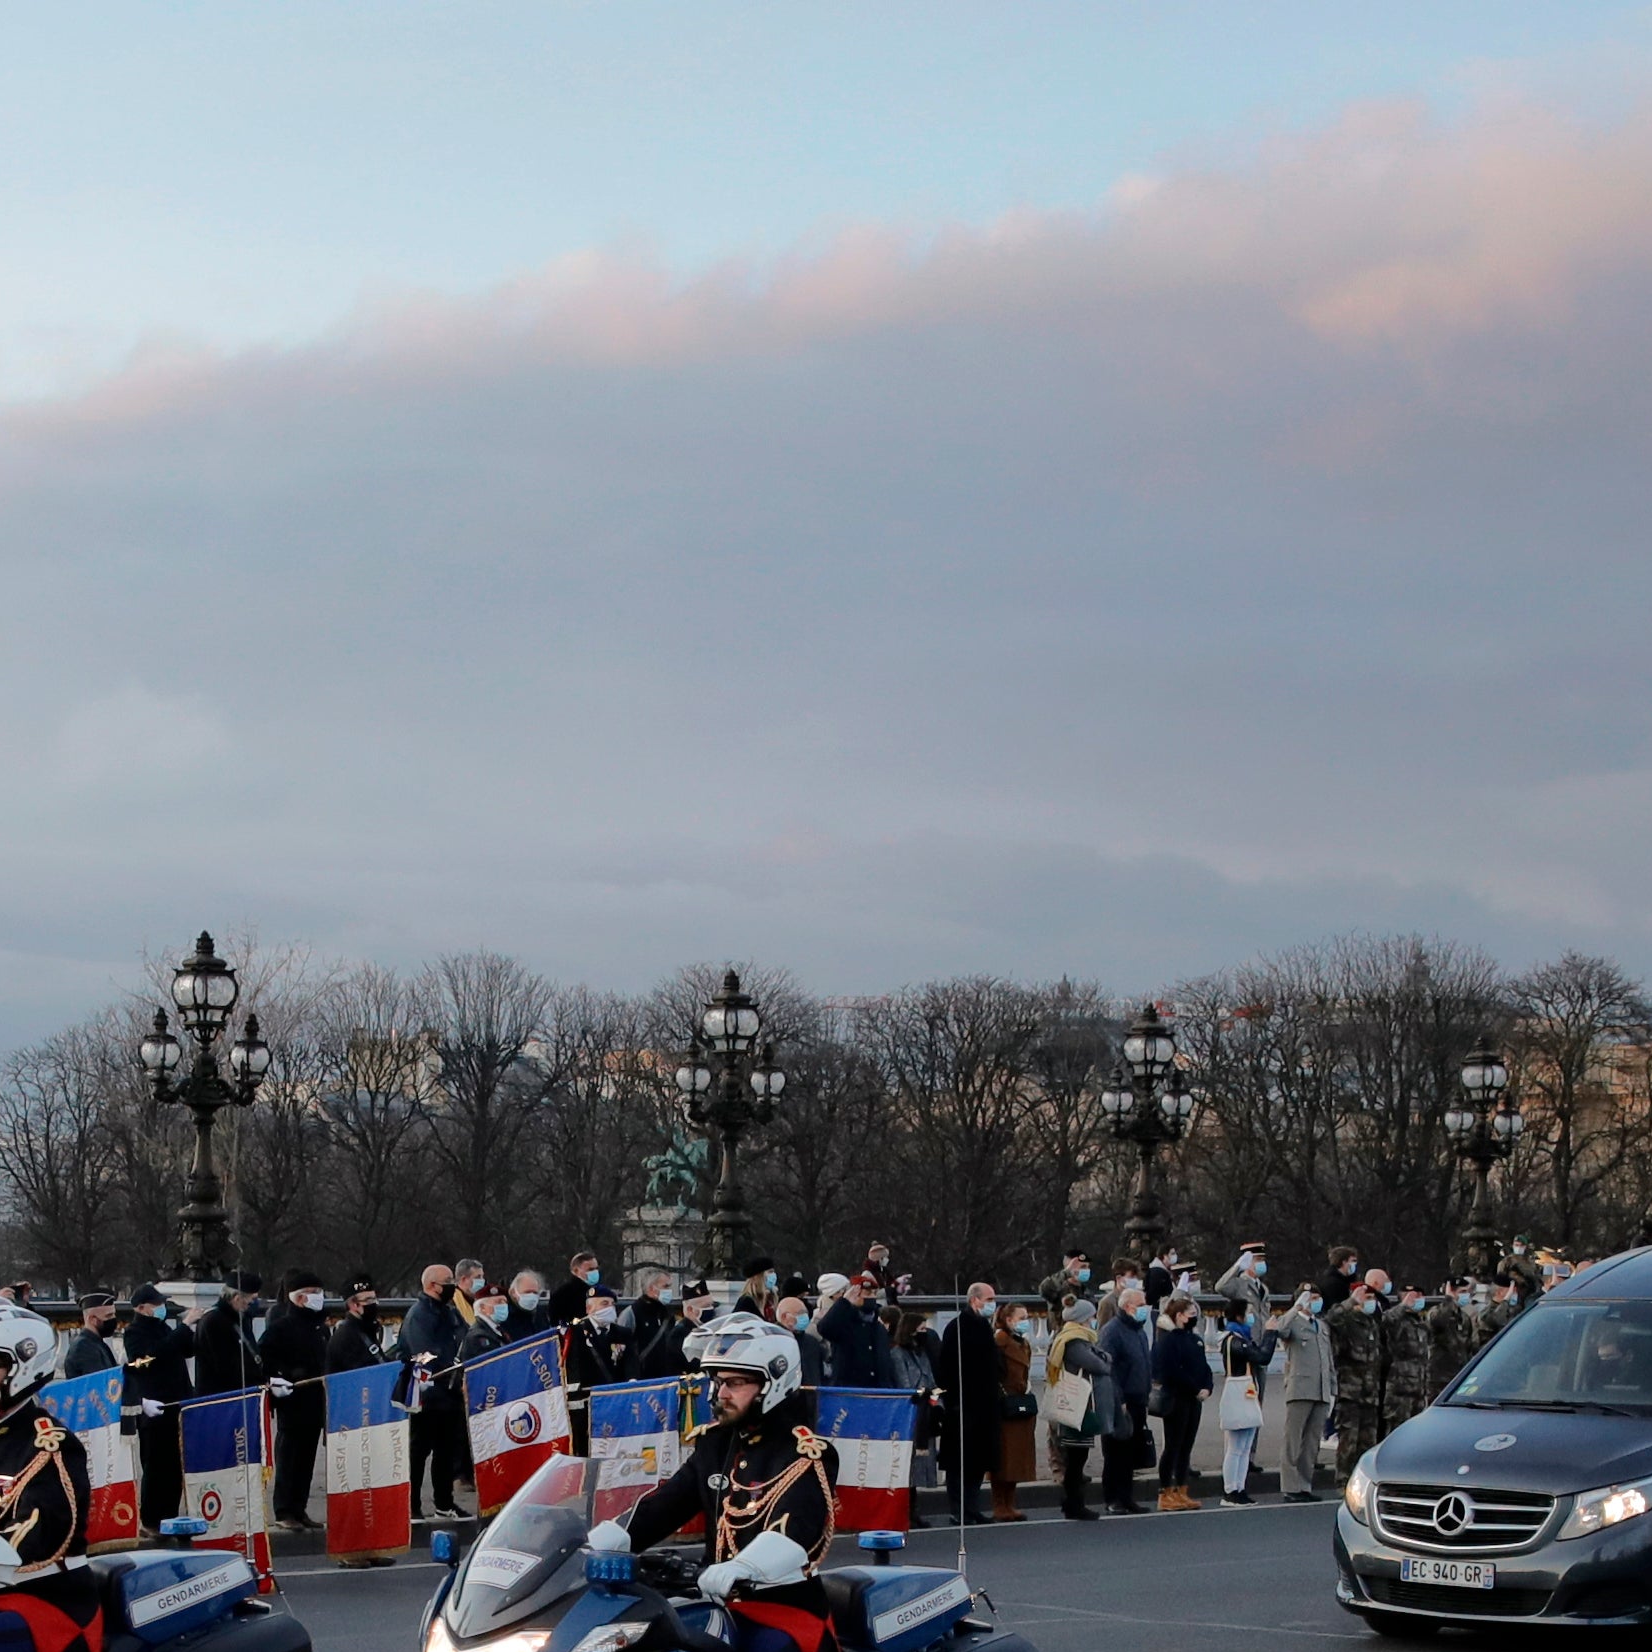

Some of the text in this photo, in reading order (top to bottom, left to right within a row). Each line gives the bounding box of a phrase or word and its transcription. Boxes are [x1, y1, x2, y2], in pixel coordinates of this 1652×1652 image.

[233, 1426, 246, 1483] SOLDATS
[389, 1428, 403, 1481] AMICALE
[857, 1433, 869, 1491] SECTION
[235, 1497, 246, 1514] DE
[361, 1455, 373, 1529] COMBATTANTS
[157, 1571, 230, 1610] GENDARMERIE
[896, 1588, 955, 1626] GENDARMERIE
